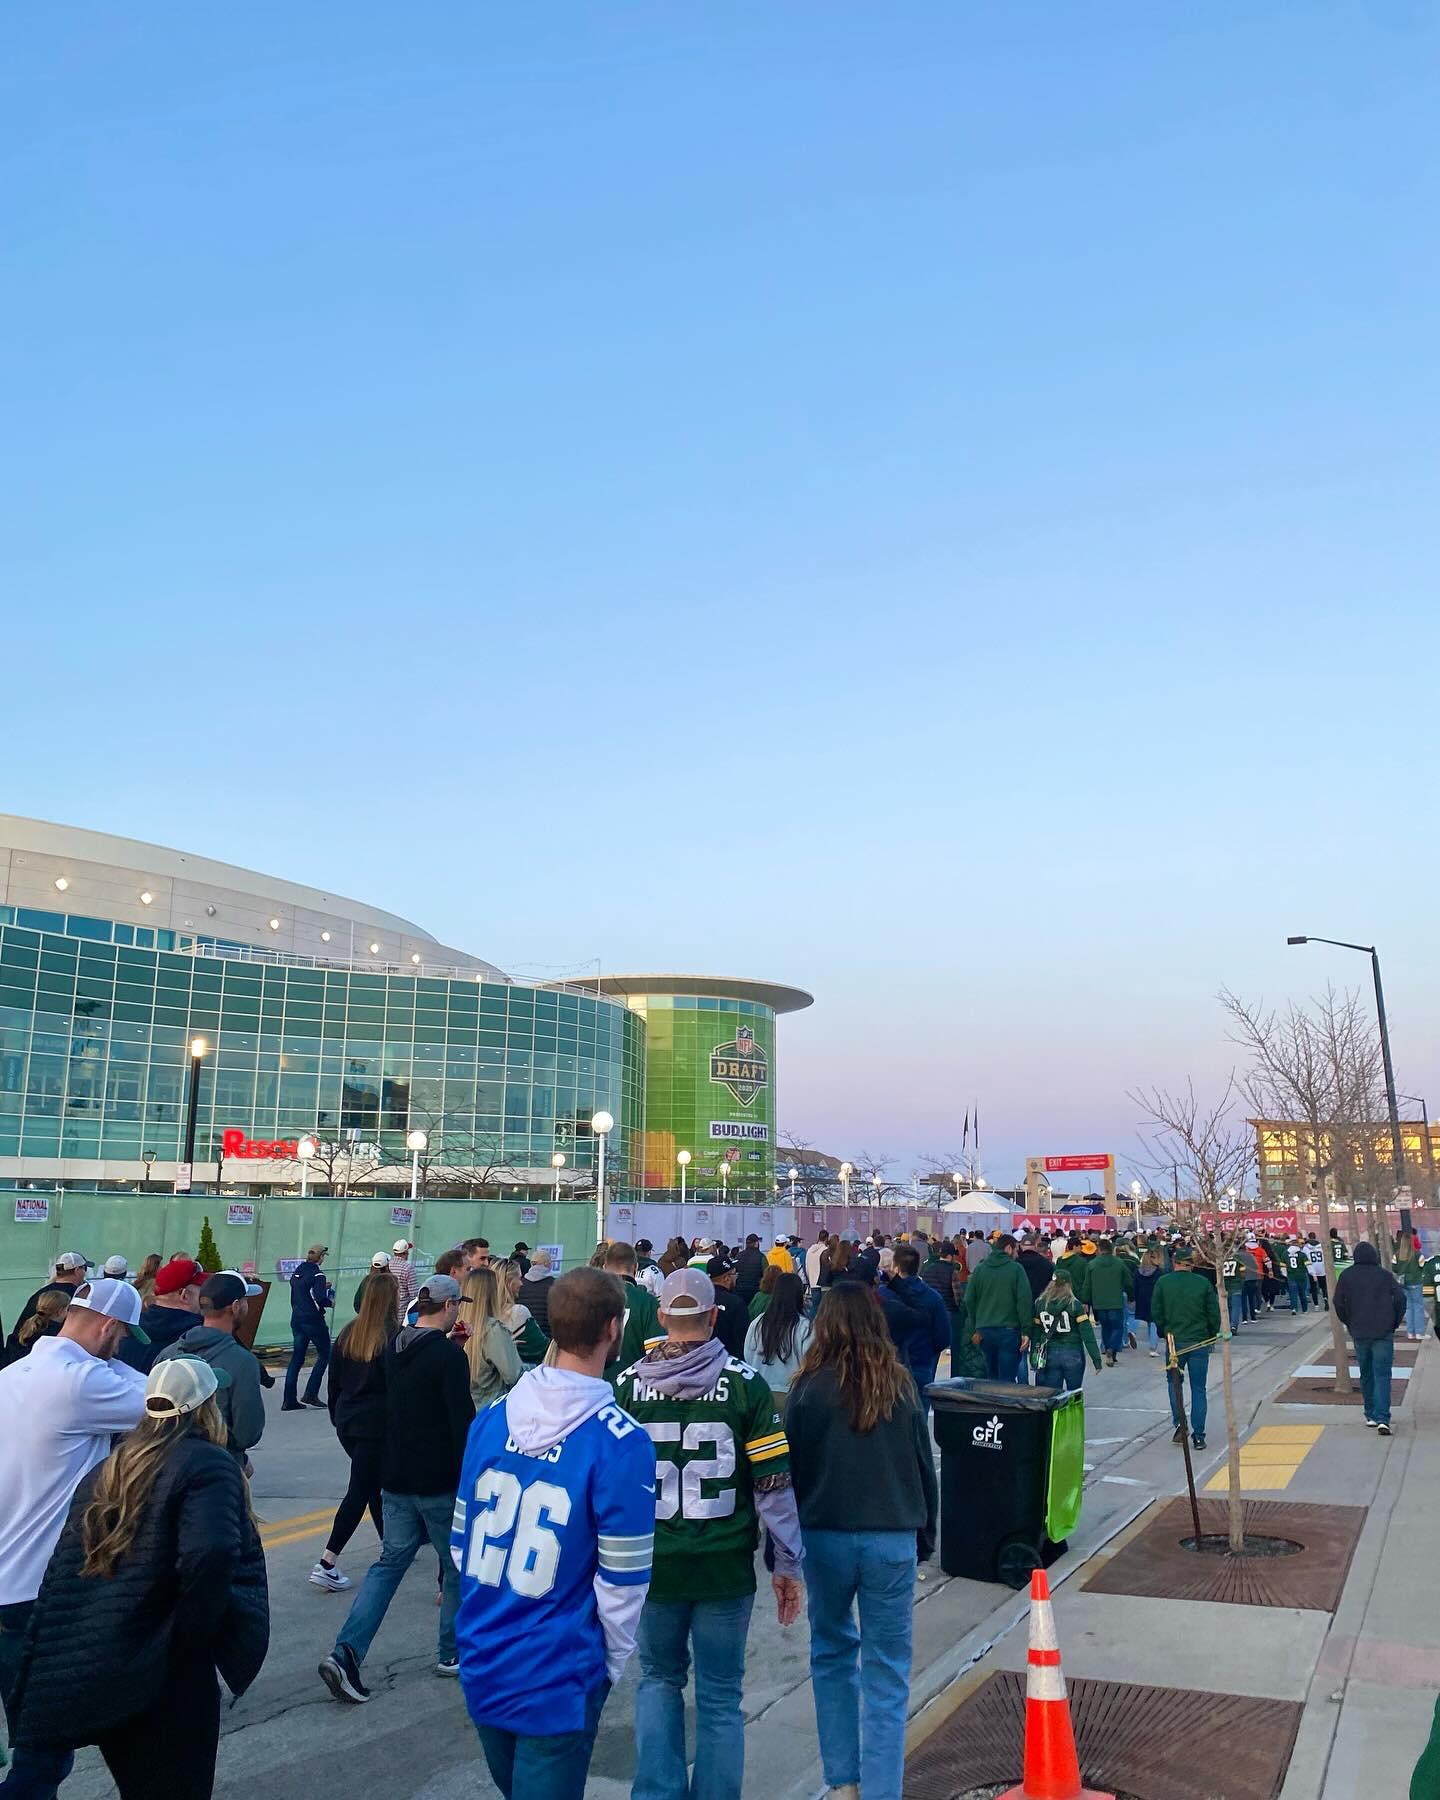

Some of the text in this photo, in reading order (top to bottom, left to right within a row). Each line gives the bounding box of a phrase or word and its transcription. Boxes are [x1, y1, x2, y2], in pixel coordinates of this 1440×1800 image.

[738, 1040, 753, 1053] NFL
[716, 1061, 767, 1079] DRAFT
[711, 1123, 768, 1139] BUD LIGHT
[1048, 1158, 1062, 1168] EXIT
[16, 1199, 48, 1210] NATIONAL
[1039, 1217, 1090, 1235] EXIT
[1289, 1257, 1298, 1269] 8
[1310, 1251, 1323, 1263] 69
[1223, 1261, 1237, 1277] 27
[972, 1421, 1003, 1445] GFL
[641, 1422, 737, 1520] 52
[466, 1467, 572, 1599] 26
